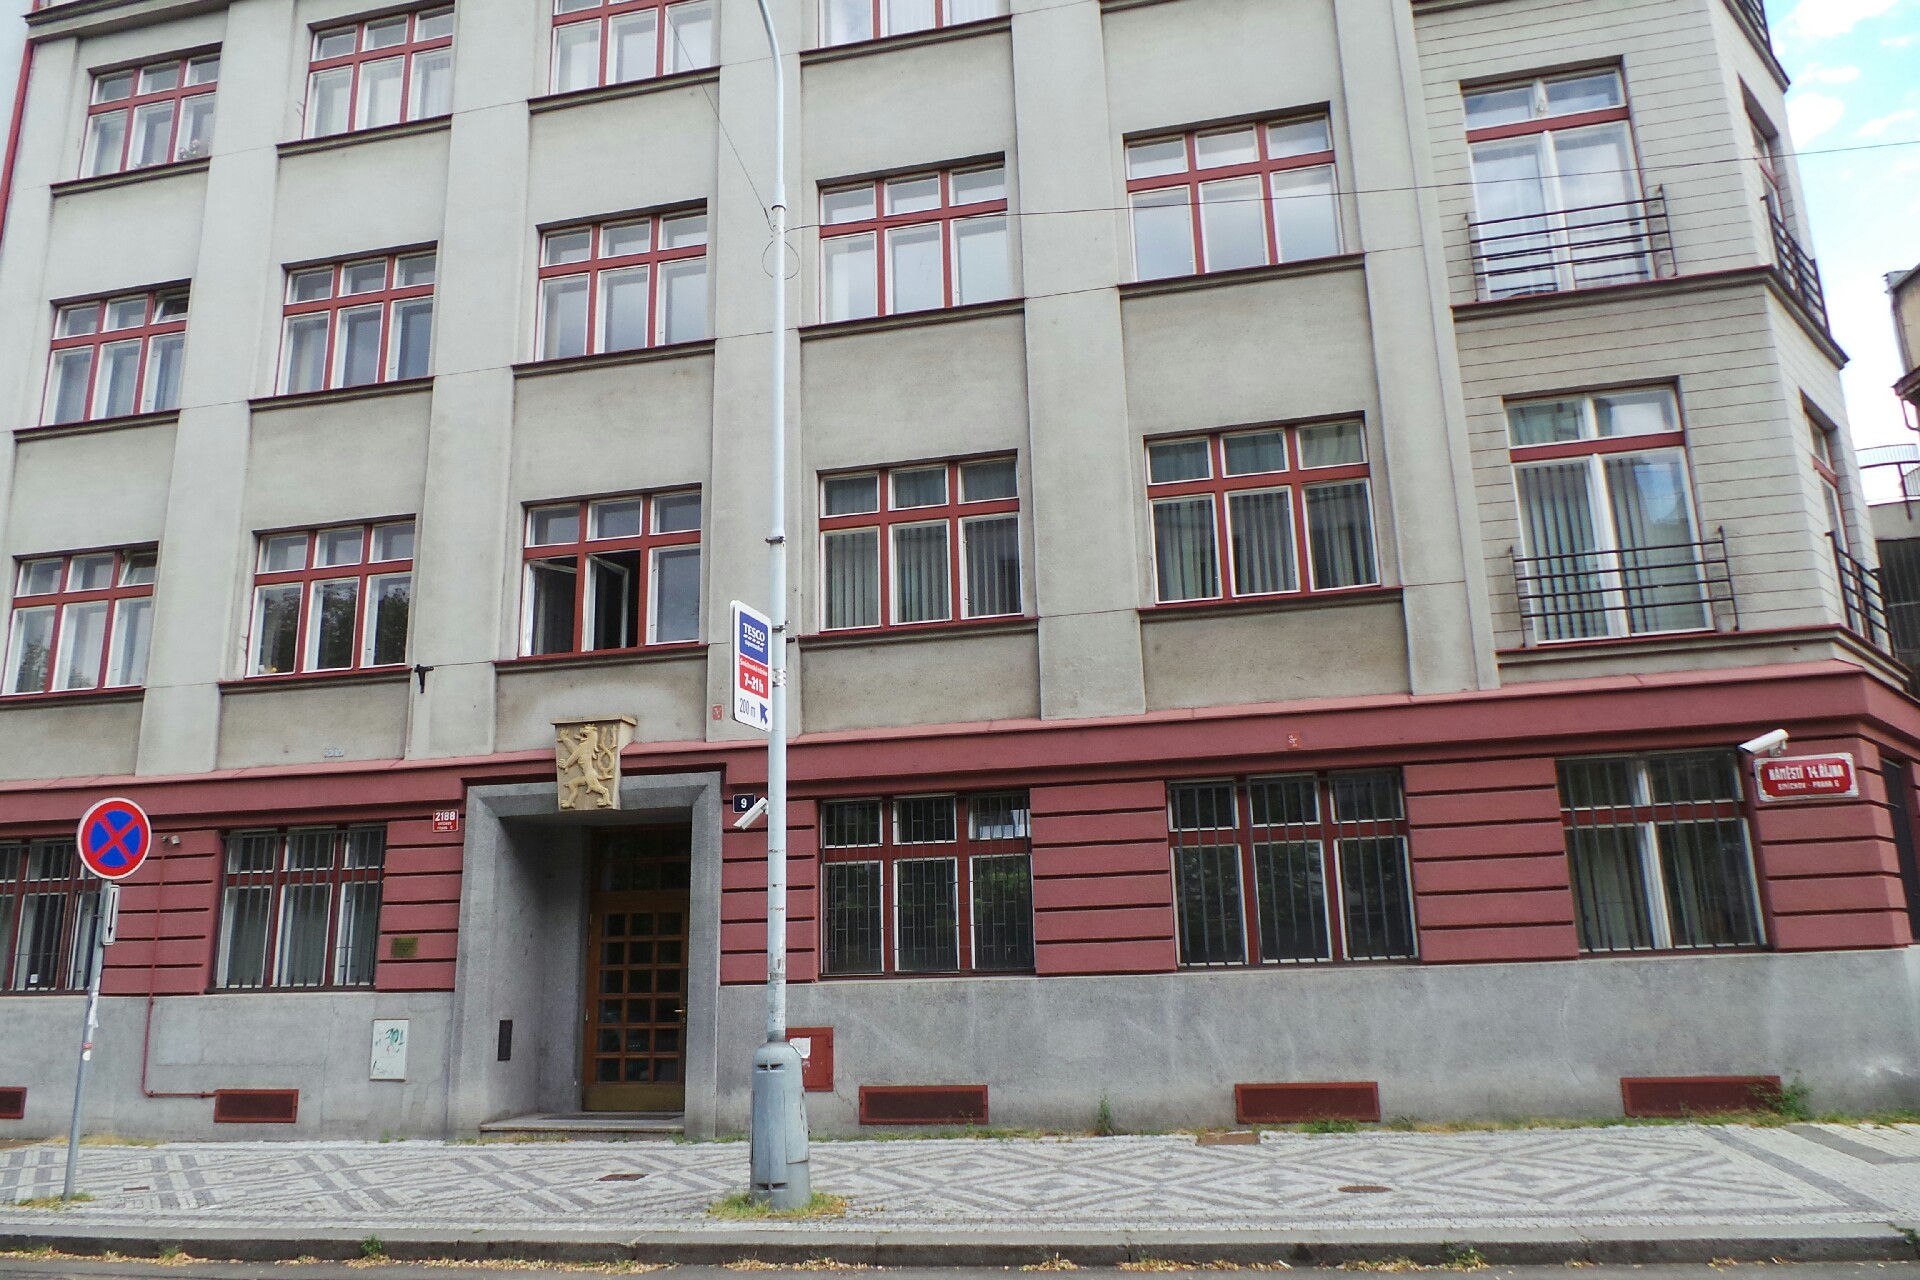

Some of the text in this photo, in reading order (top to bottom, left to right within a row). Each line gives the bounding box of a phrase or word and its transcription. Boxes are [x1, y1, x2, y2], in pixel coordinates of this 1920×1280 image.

[743, 623, 765, 642] TESCO
[740, 698, 756, 718] 200 m
[1768, 765, 1804, 780] NÁMĚSTÍ
[740, 798, 747, 808] 9
[435, 811, 455, 821] 2188
